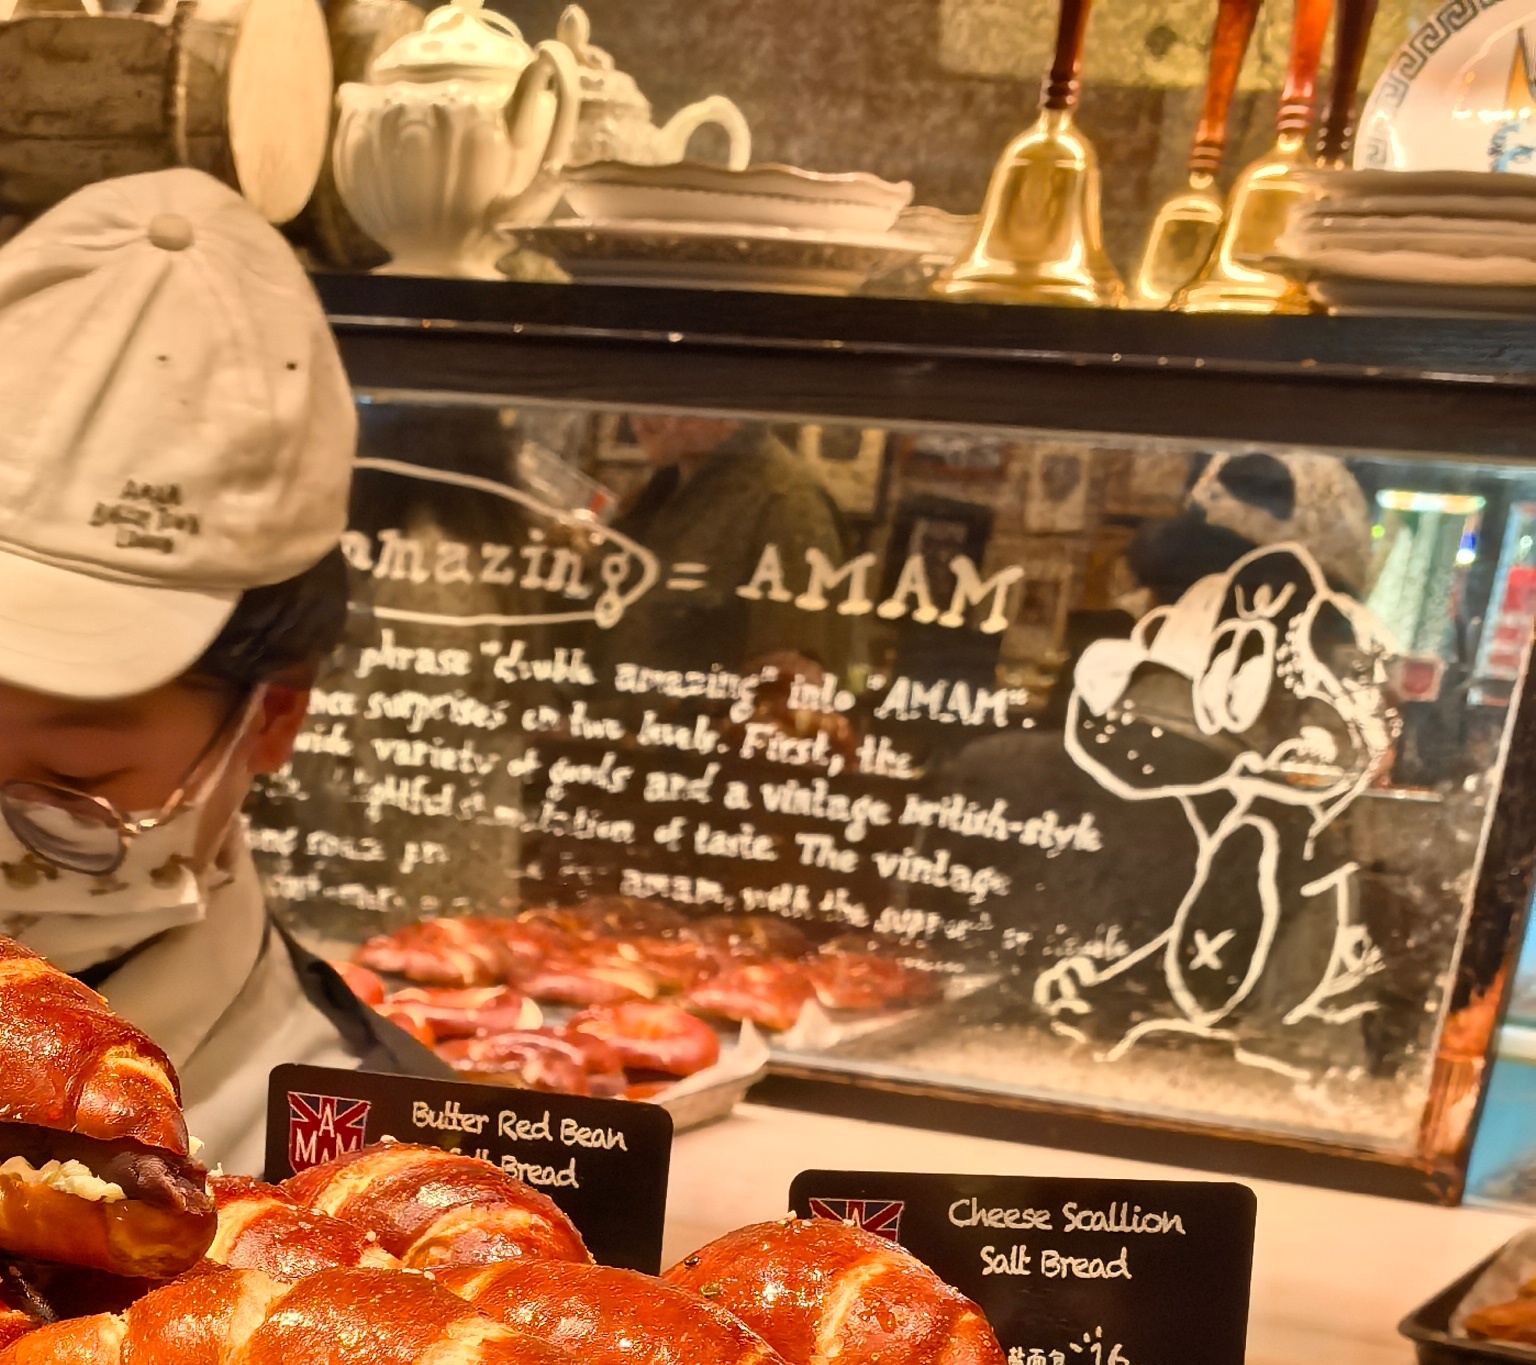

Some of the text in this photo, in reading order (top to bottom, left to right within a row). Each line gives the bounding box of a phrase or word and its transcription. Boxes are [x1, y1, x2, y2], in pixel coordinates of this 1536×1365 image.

[340, 527, 625, 629] amazing
[735, 543, 1025, 634] AMAM
[355, 628, 471, 679] phrase
[787, 672, 856, 714] into
[644, 761, 722, 805] and
[723, 780, 753, 811] a
[760, 776, 892, 843] vintage
[795, 832, 860, 873] The
[412, 1100, 629, 1152] Butter Red Bean
[501, 1154, 580, 1189] Bread
[948, 1198, 1187, 1236] Cheese Scallion
[980, 1246, 1133, 1280] Salt Bread
